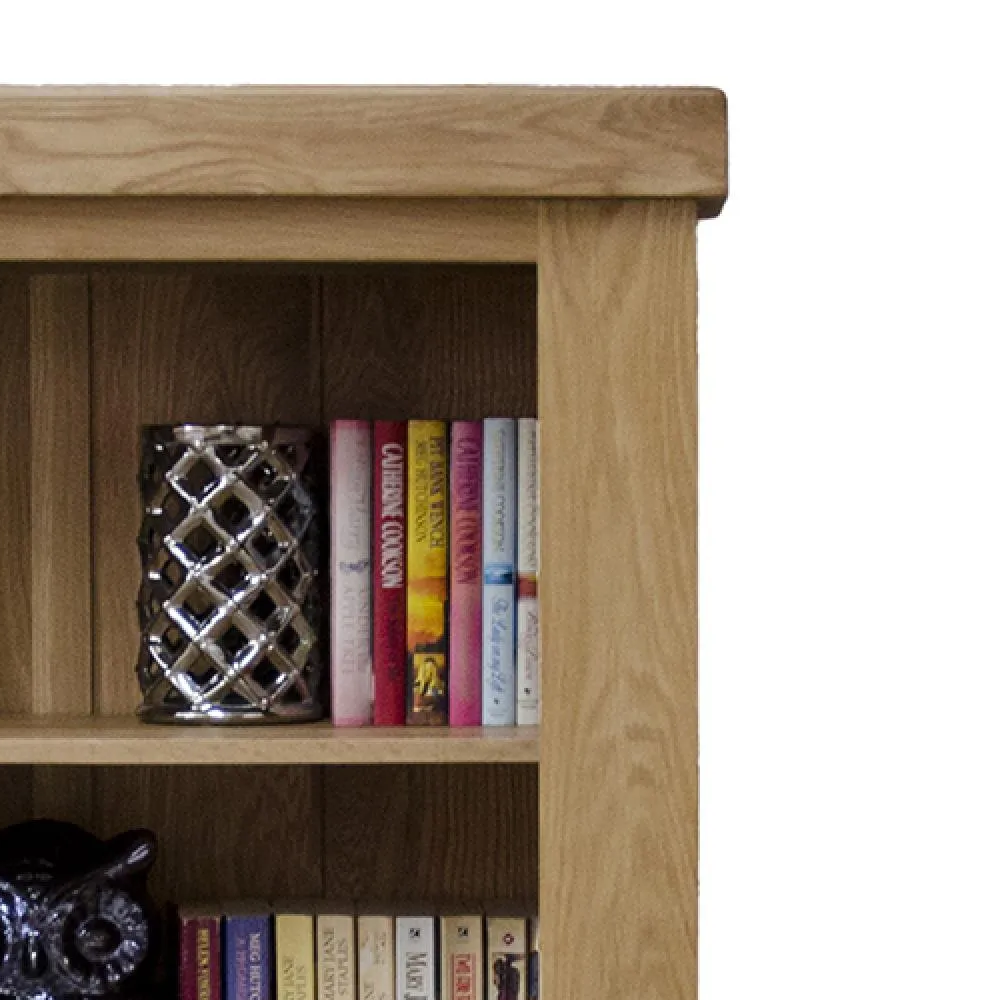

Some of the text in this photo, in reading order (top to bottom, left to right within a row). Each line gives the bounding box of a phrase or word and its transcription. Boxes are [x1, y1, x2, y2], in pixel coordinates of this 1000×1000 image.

[382, 442, 403, 518] CATHERINE
[430, 459, 444, 497] BANK
[430, 500, 444, 548] WENCH
[456, 437, 480, 584] CATHERINE COOKSON
[382, 520, 404, 588] COOKSON
[249, 933, 262, 962] MEG
[323, 928, 335, 964] JANE
[337, 938, 349, 997] STAPLES
[406, 951, 429, 991] MARY
